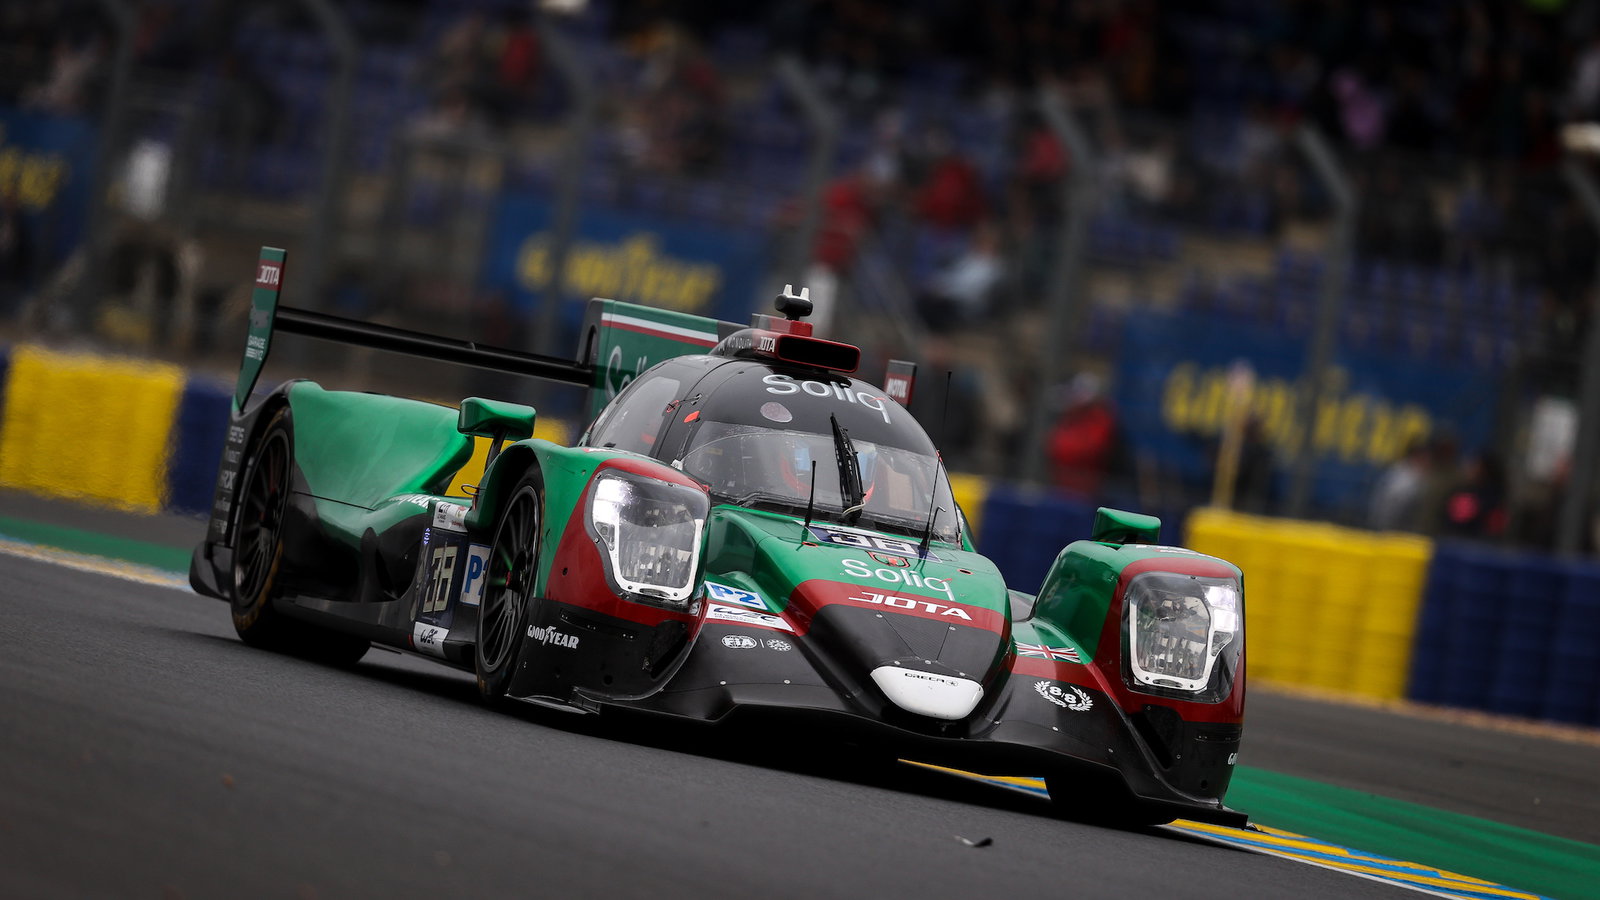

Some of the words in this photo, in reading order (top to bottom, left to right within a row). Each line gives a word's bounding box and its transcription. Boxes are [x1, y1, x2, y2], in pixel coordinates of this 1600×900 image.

[256, 265, 280, 285] JOTA
[757, 336, 776, 353] JOTA
[762, 374, 892, 424] Soliq
[826, 529, 916, 554] 38
[423, 546, 458, 613] 38
[841, 558, 956, 601] Soliq
[709, 584, 761, 606] P2
[848, 591, 973, 621] JOTA
[527, 625, 580, 650] GOODYEAR
[725, 635, 755, 648] FIA
